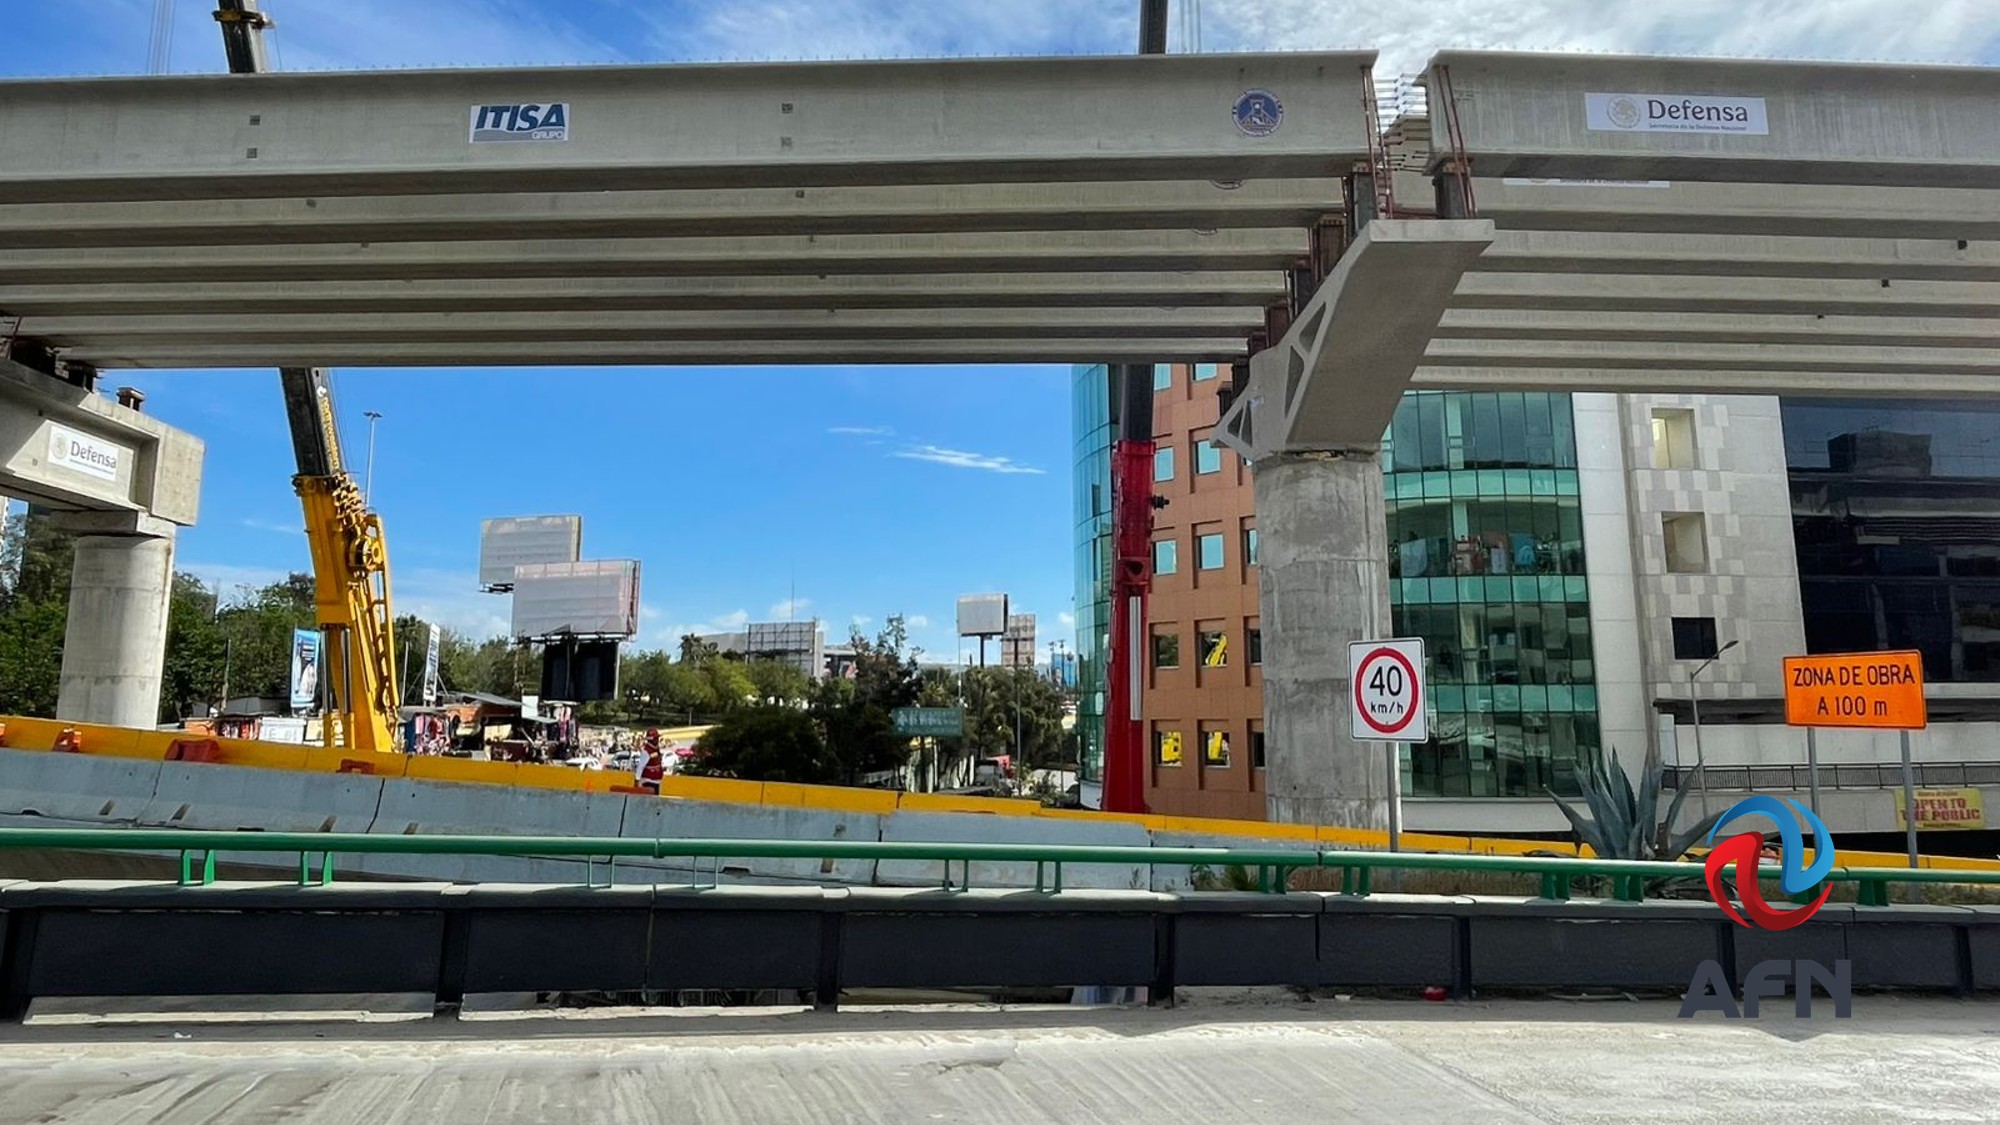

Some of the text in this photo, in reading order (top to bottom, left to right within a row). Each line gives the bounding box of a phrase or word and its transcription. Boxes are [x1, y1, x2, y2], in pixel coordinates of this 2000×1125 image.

[475, 104, 565, 131] ITISA
[1648, 99, 1748, 122] Defensa
[531, 130, 564, 139] GRUPO
[70, 440, 116, 469] Defensa
[1369, 665, 1402, 696] 40
[1793, 663, 1916, 687] ZONA DE OBRA
[1370, 701, 1403, 714] km/h
[1817, 695, 1888, 716] A 100 m
[1932, 808, 1980, 821] PUBLIC
